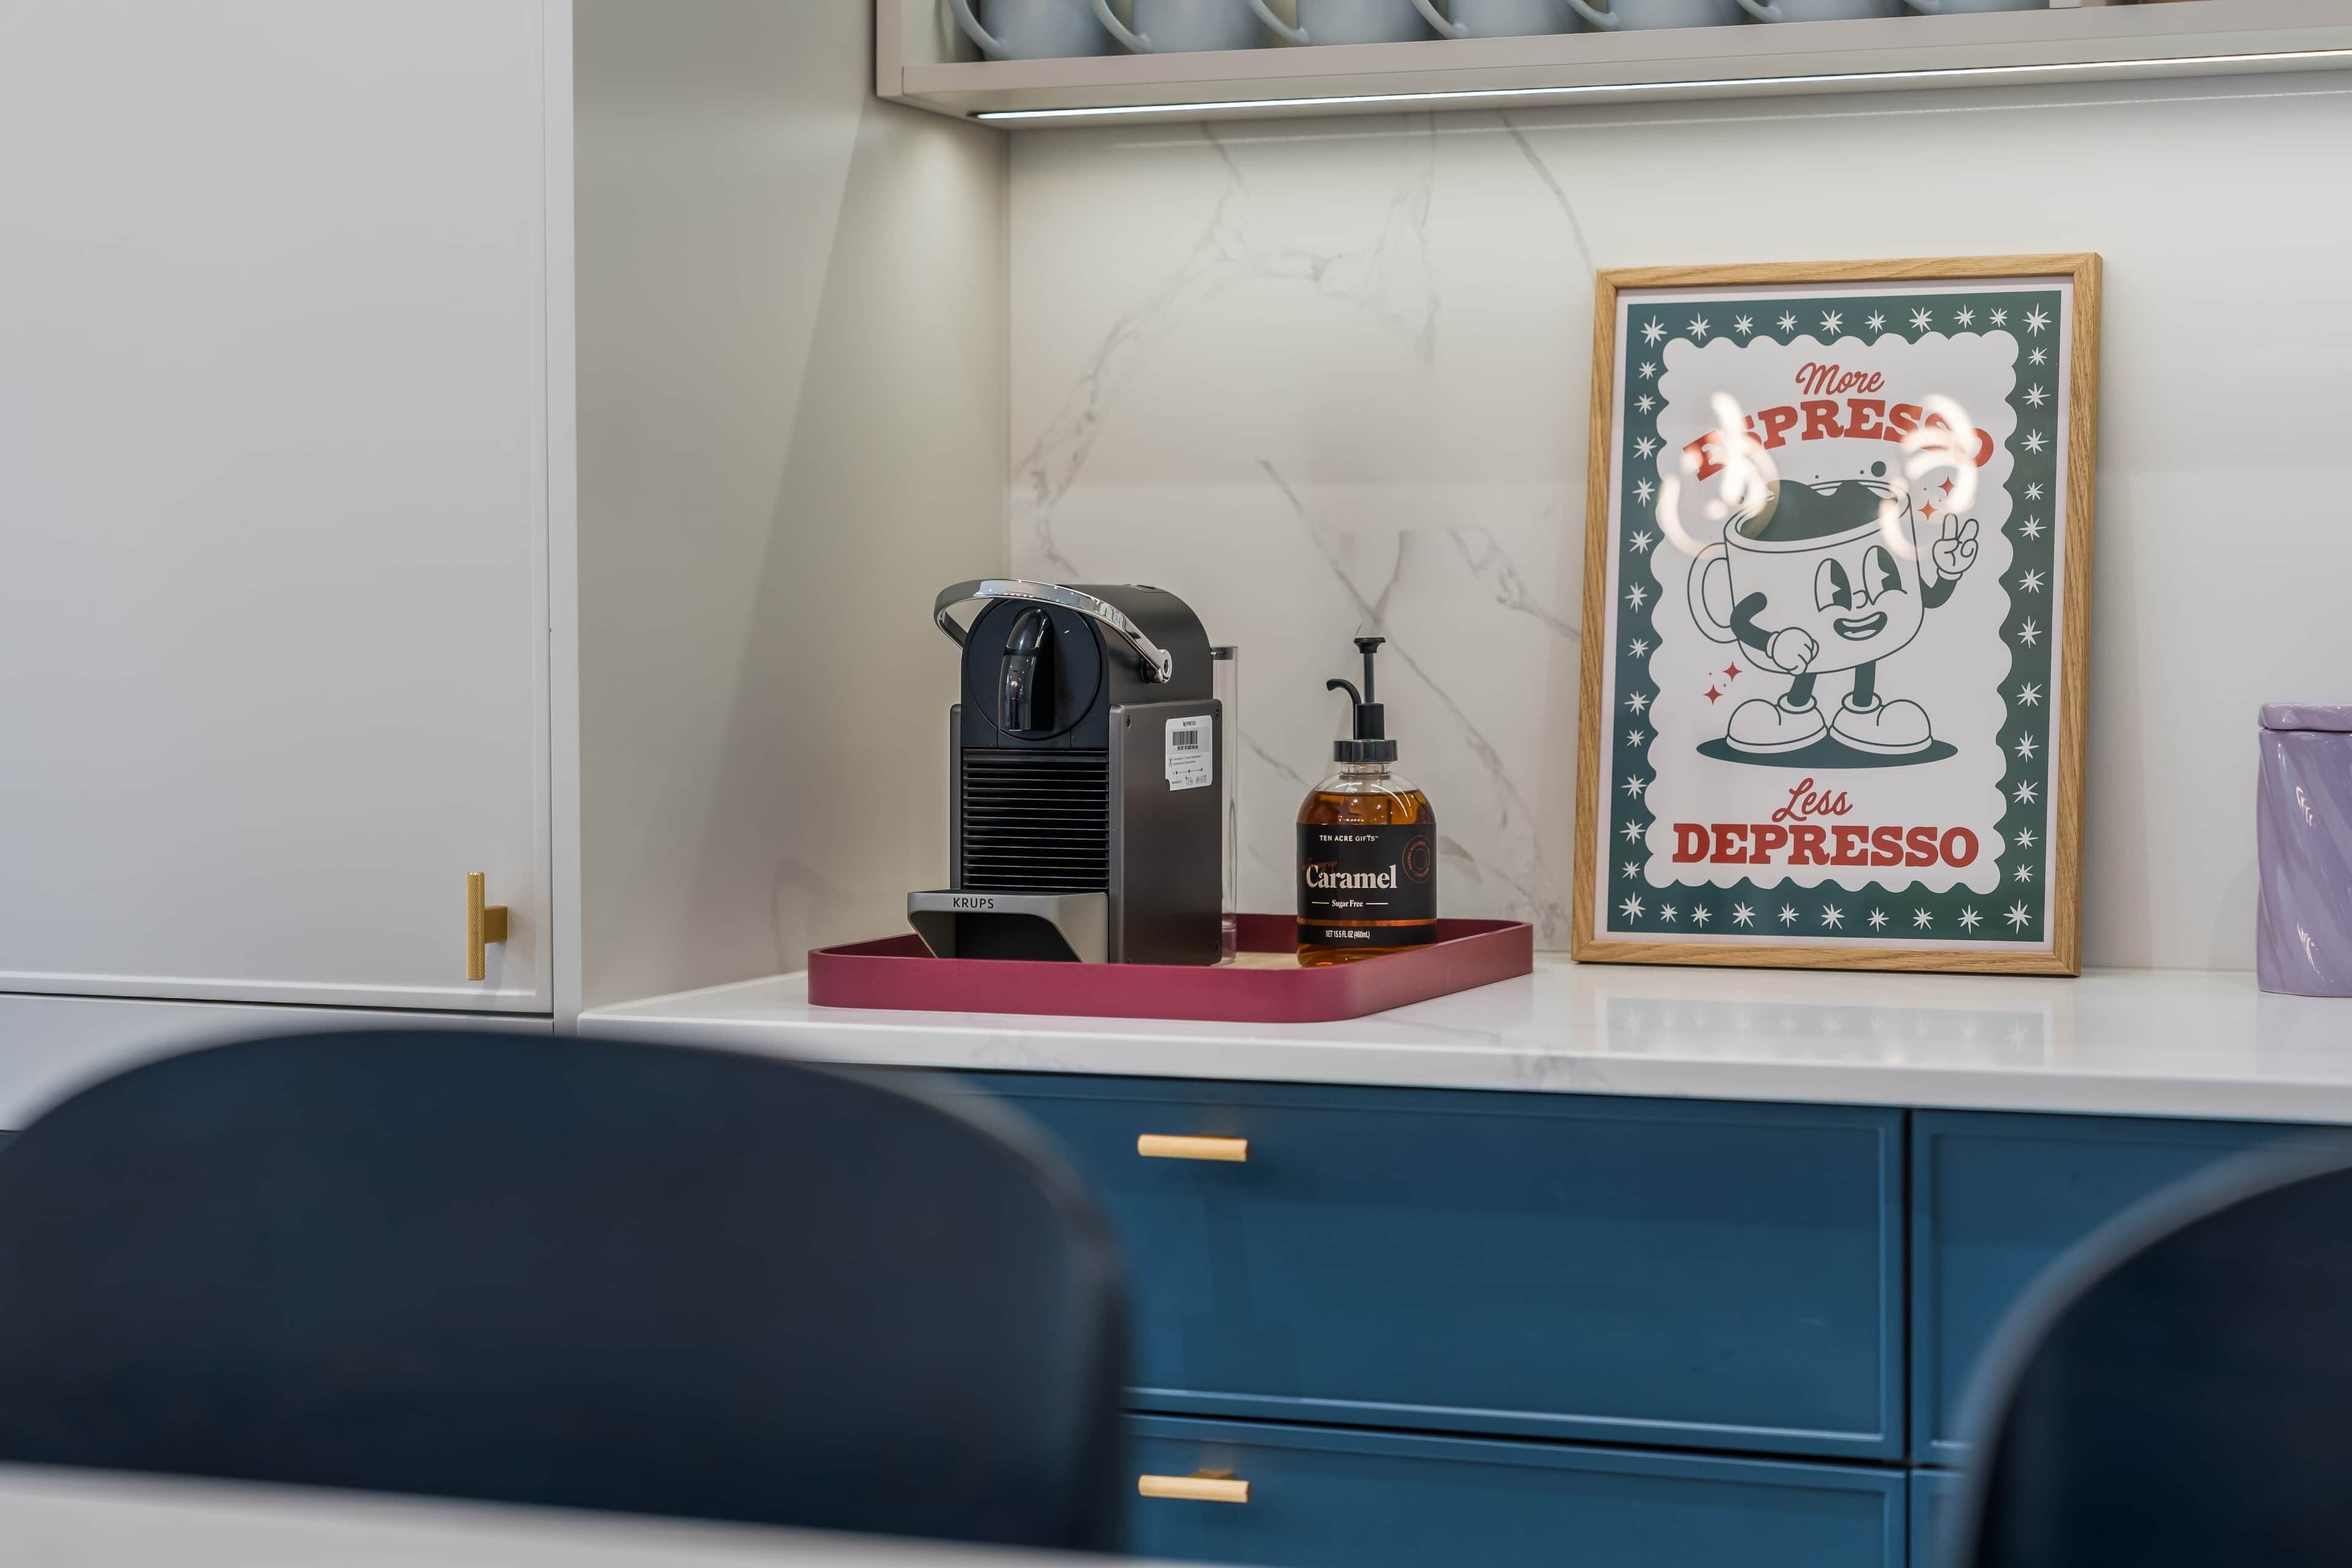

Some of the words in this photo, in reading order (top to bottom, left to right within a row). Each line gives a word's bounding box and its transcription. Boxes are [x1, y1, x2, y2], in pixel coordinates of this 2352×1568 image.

[1795, 362, 1885, 395] More
[1771, 778, 1853, 823] Less
[1672, 824, 1979, 868] DEPRESSO
[1306, 864, 1398, 889] Caramel
[953, 897, 994, 909] KRUPS
[1332, 900, 1348, 908] Sugar
